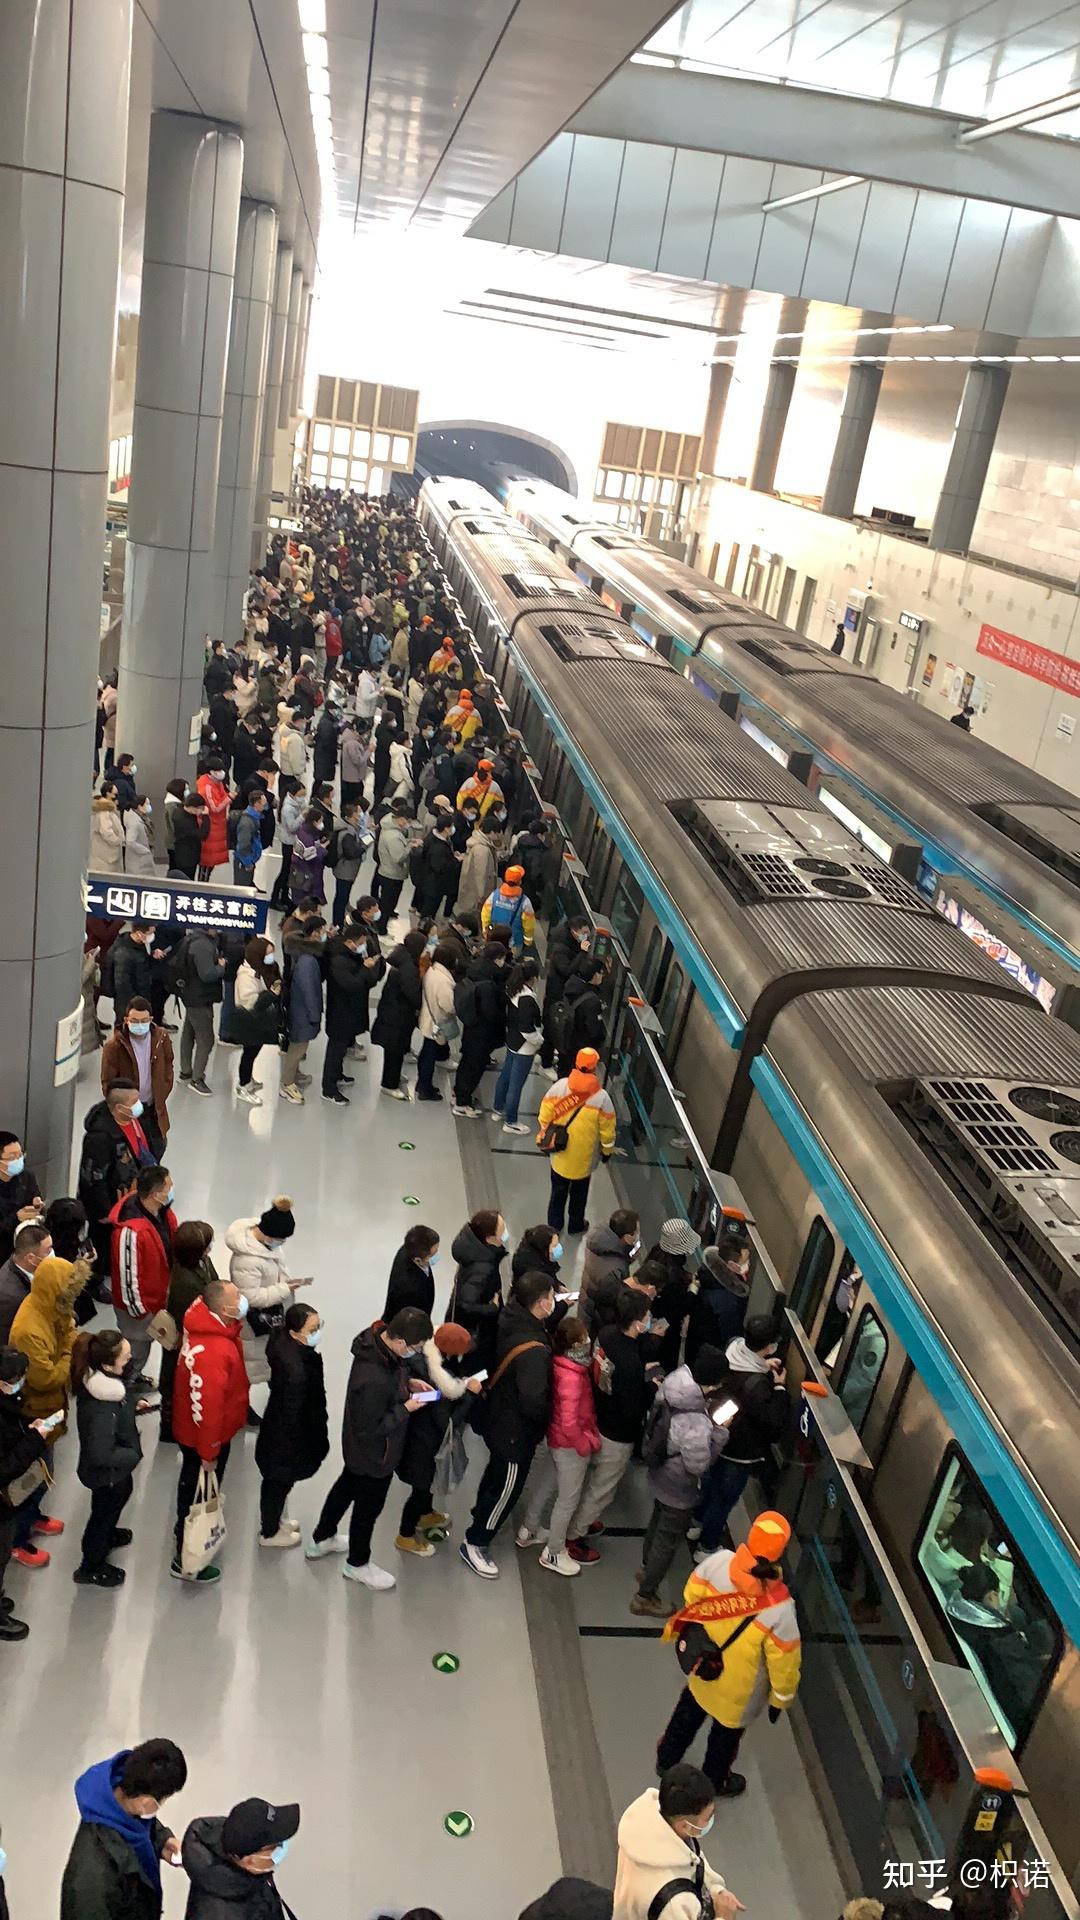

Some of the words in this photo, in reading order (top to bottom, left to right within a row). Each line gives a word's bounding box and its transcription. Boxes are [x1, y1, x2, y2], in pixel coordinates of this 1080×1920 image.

[176, 895, 257, 917] 开往天宫院
